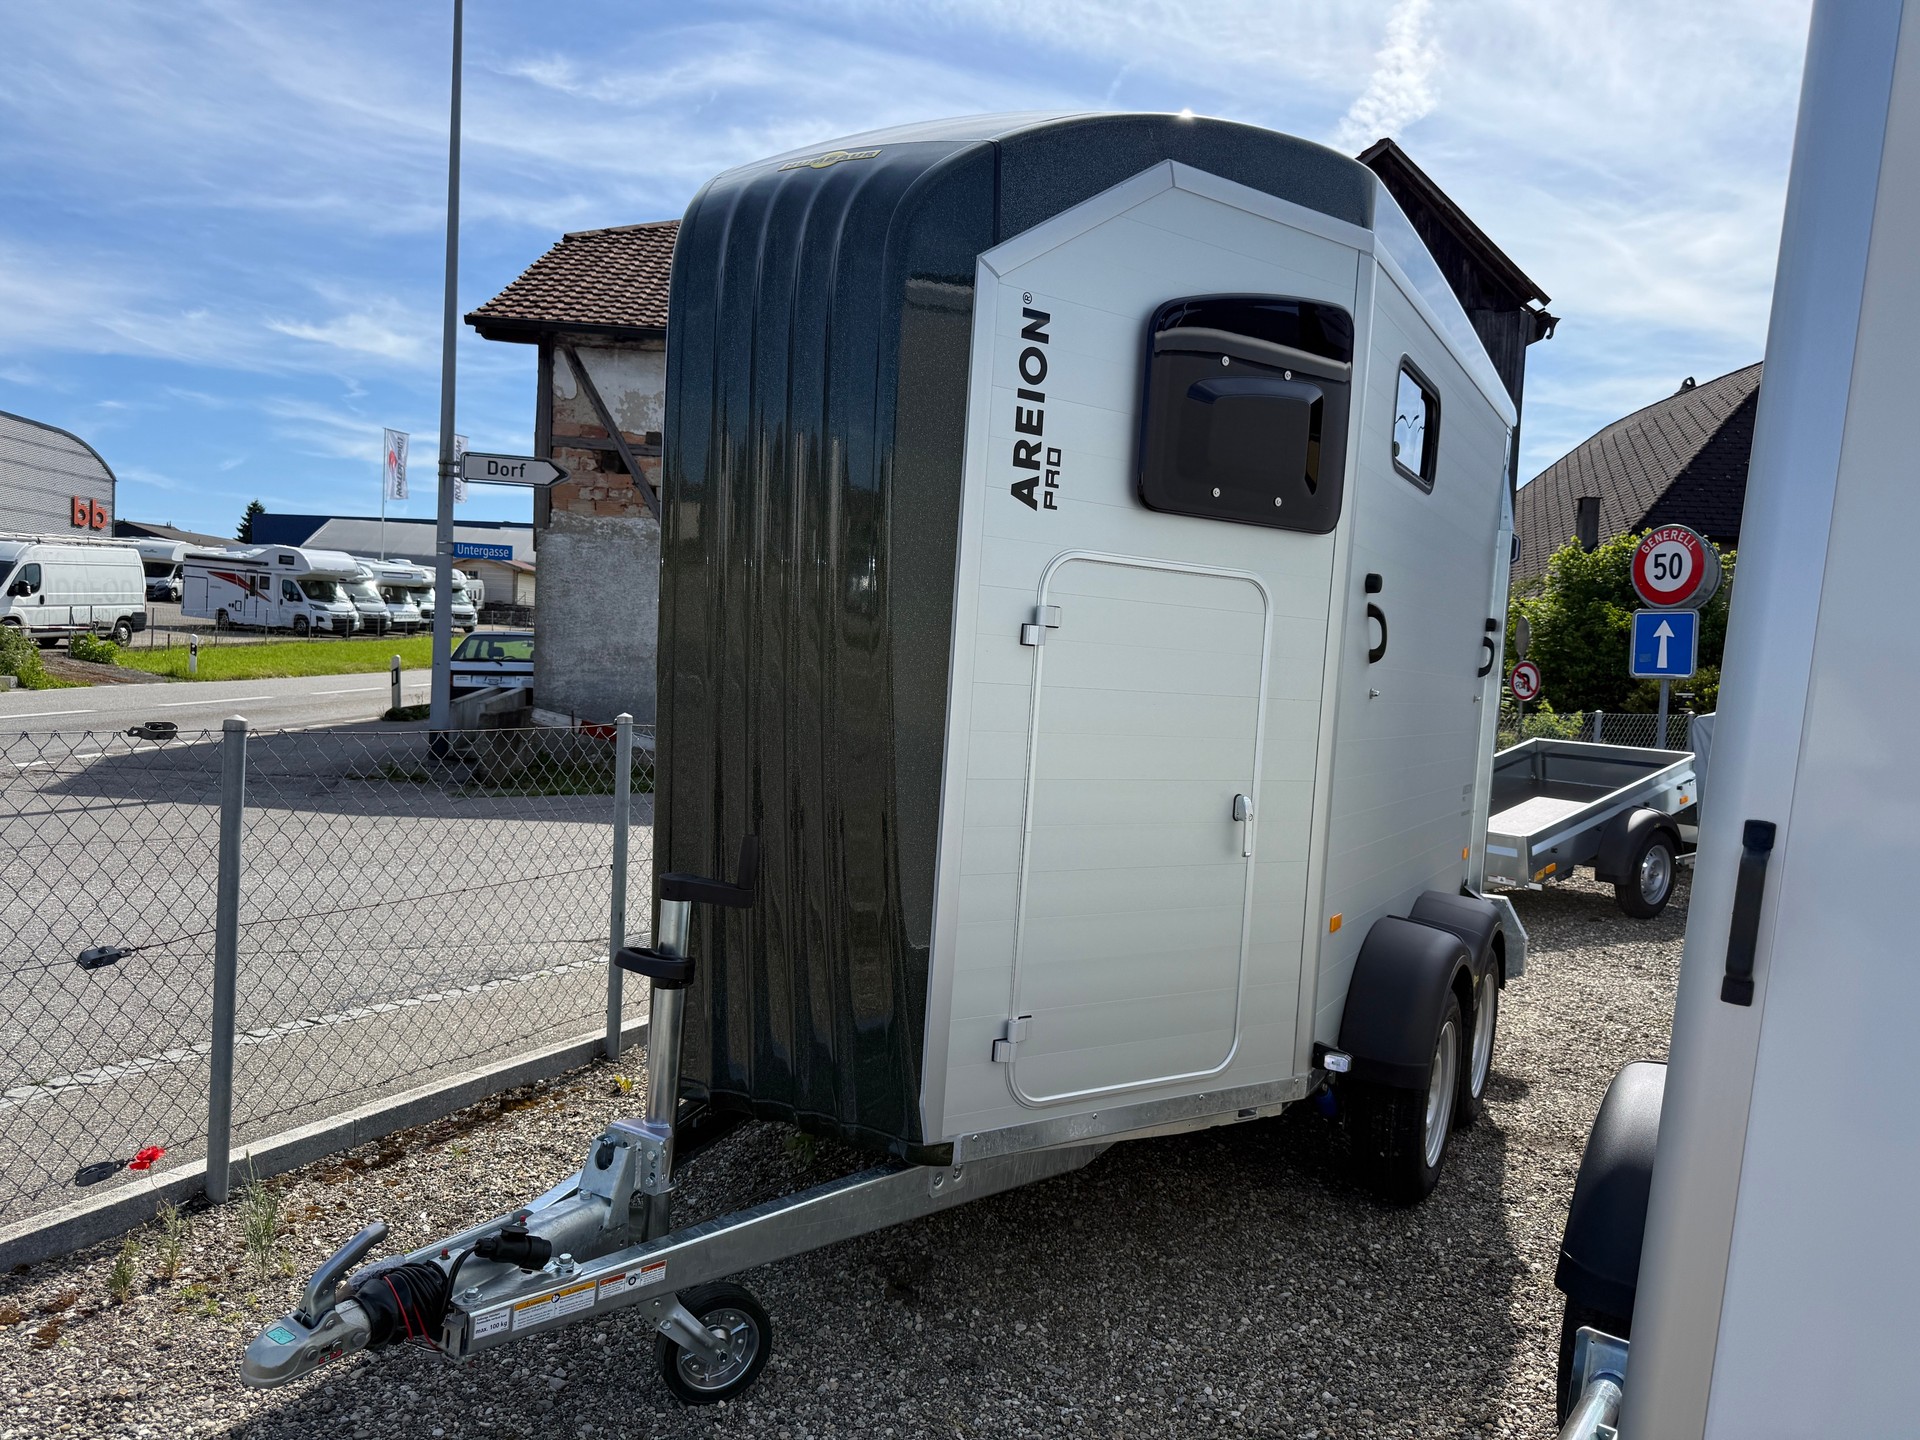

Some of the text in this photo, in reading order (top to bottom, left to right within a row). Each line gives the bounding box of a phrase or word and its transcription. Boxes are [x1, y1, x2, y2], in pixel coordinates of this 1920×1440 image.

[487, 460, 526, 478] Dorf
[1043, 446, 1062, 510] PRO
[73, 495, 108, 529] bb
[457, 544, 509, 559] Untergasse
[1641, 529, 1698, 554] GENERELL
[1653, 552, 1683, 581] 50
[475, 1320, 508, 1335] max. 100 kg
